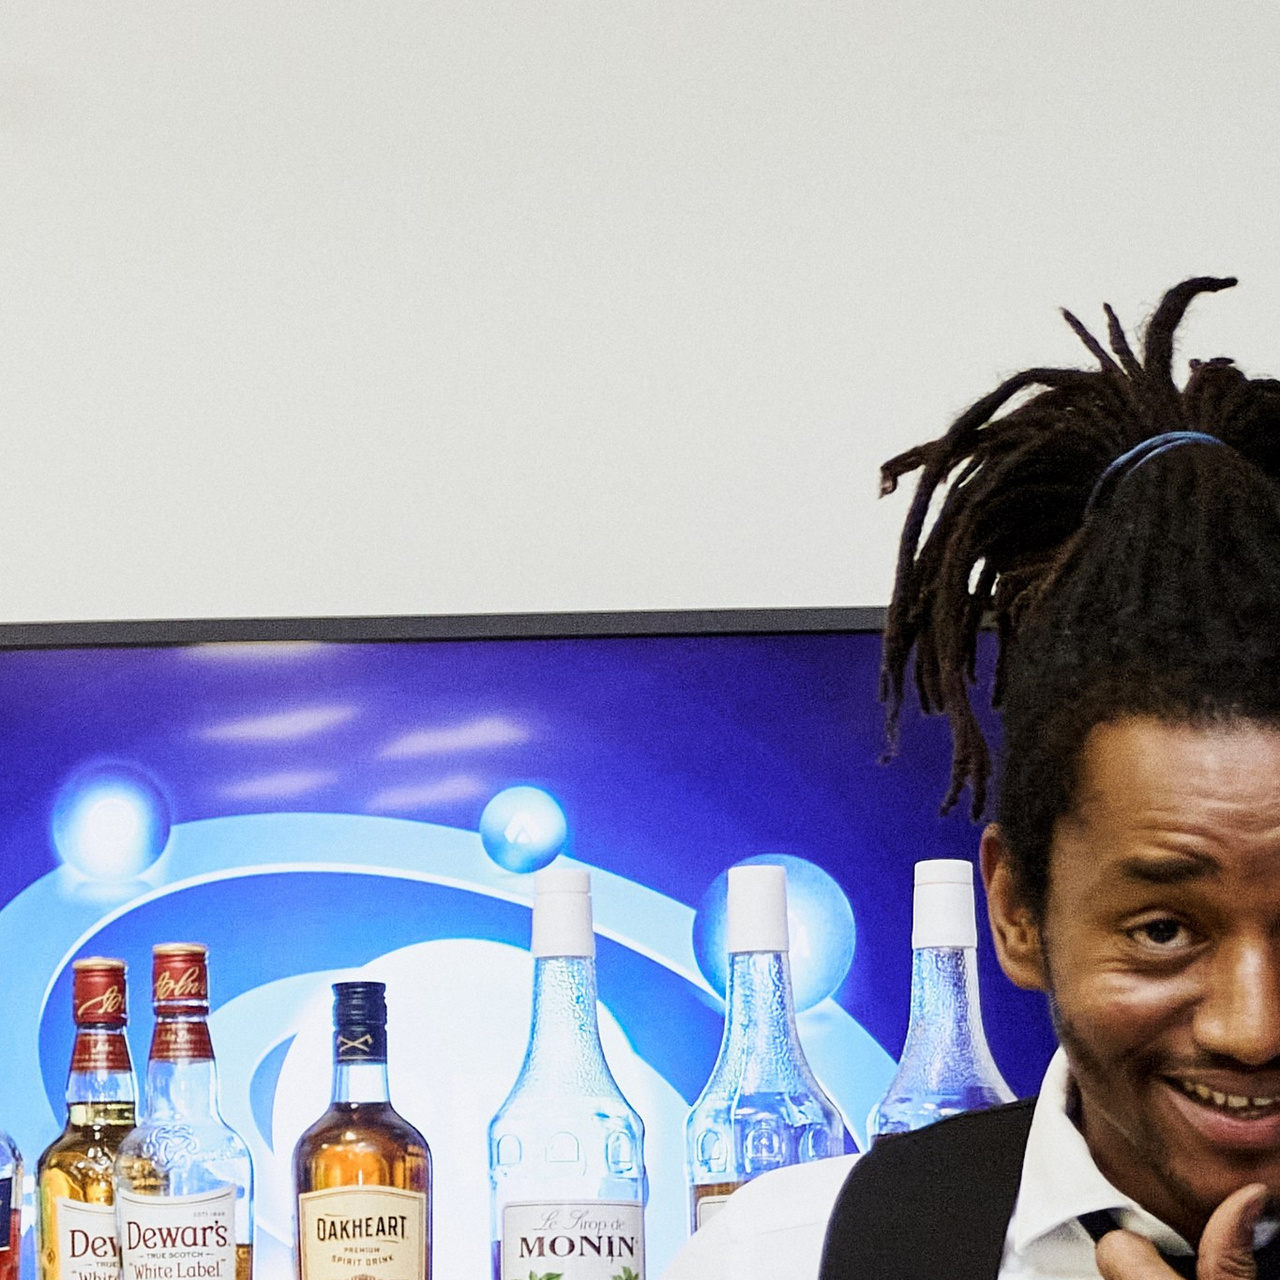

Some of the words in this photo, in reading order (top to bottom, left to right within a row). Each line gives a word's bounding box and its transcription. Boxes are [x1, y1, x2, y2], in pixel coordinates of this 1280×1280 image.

[127, 1219, 228, 1251] Dewar's
[317, 1215, 407, 1242] OAKHEART
[610, 1218, 625, 1231] de
[331, 1255, 362, 1267] SPIRIT
[365, 1255, 395, 1267] DRINK
[519, 1235, 635, 1261] MONIN
